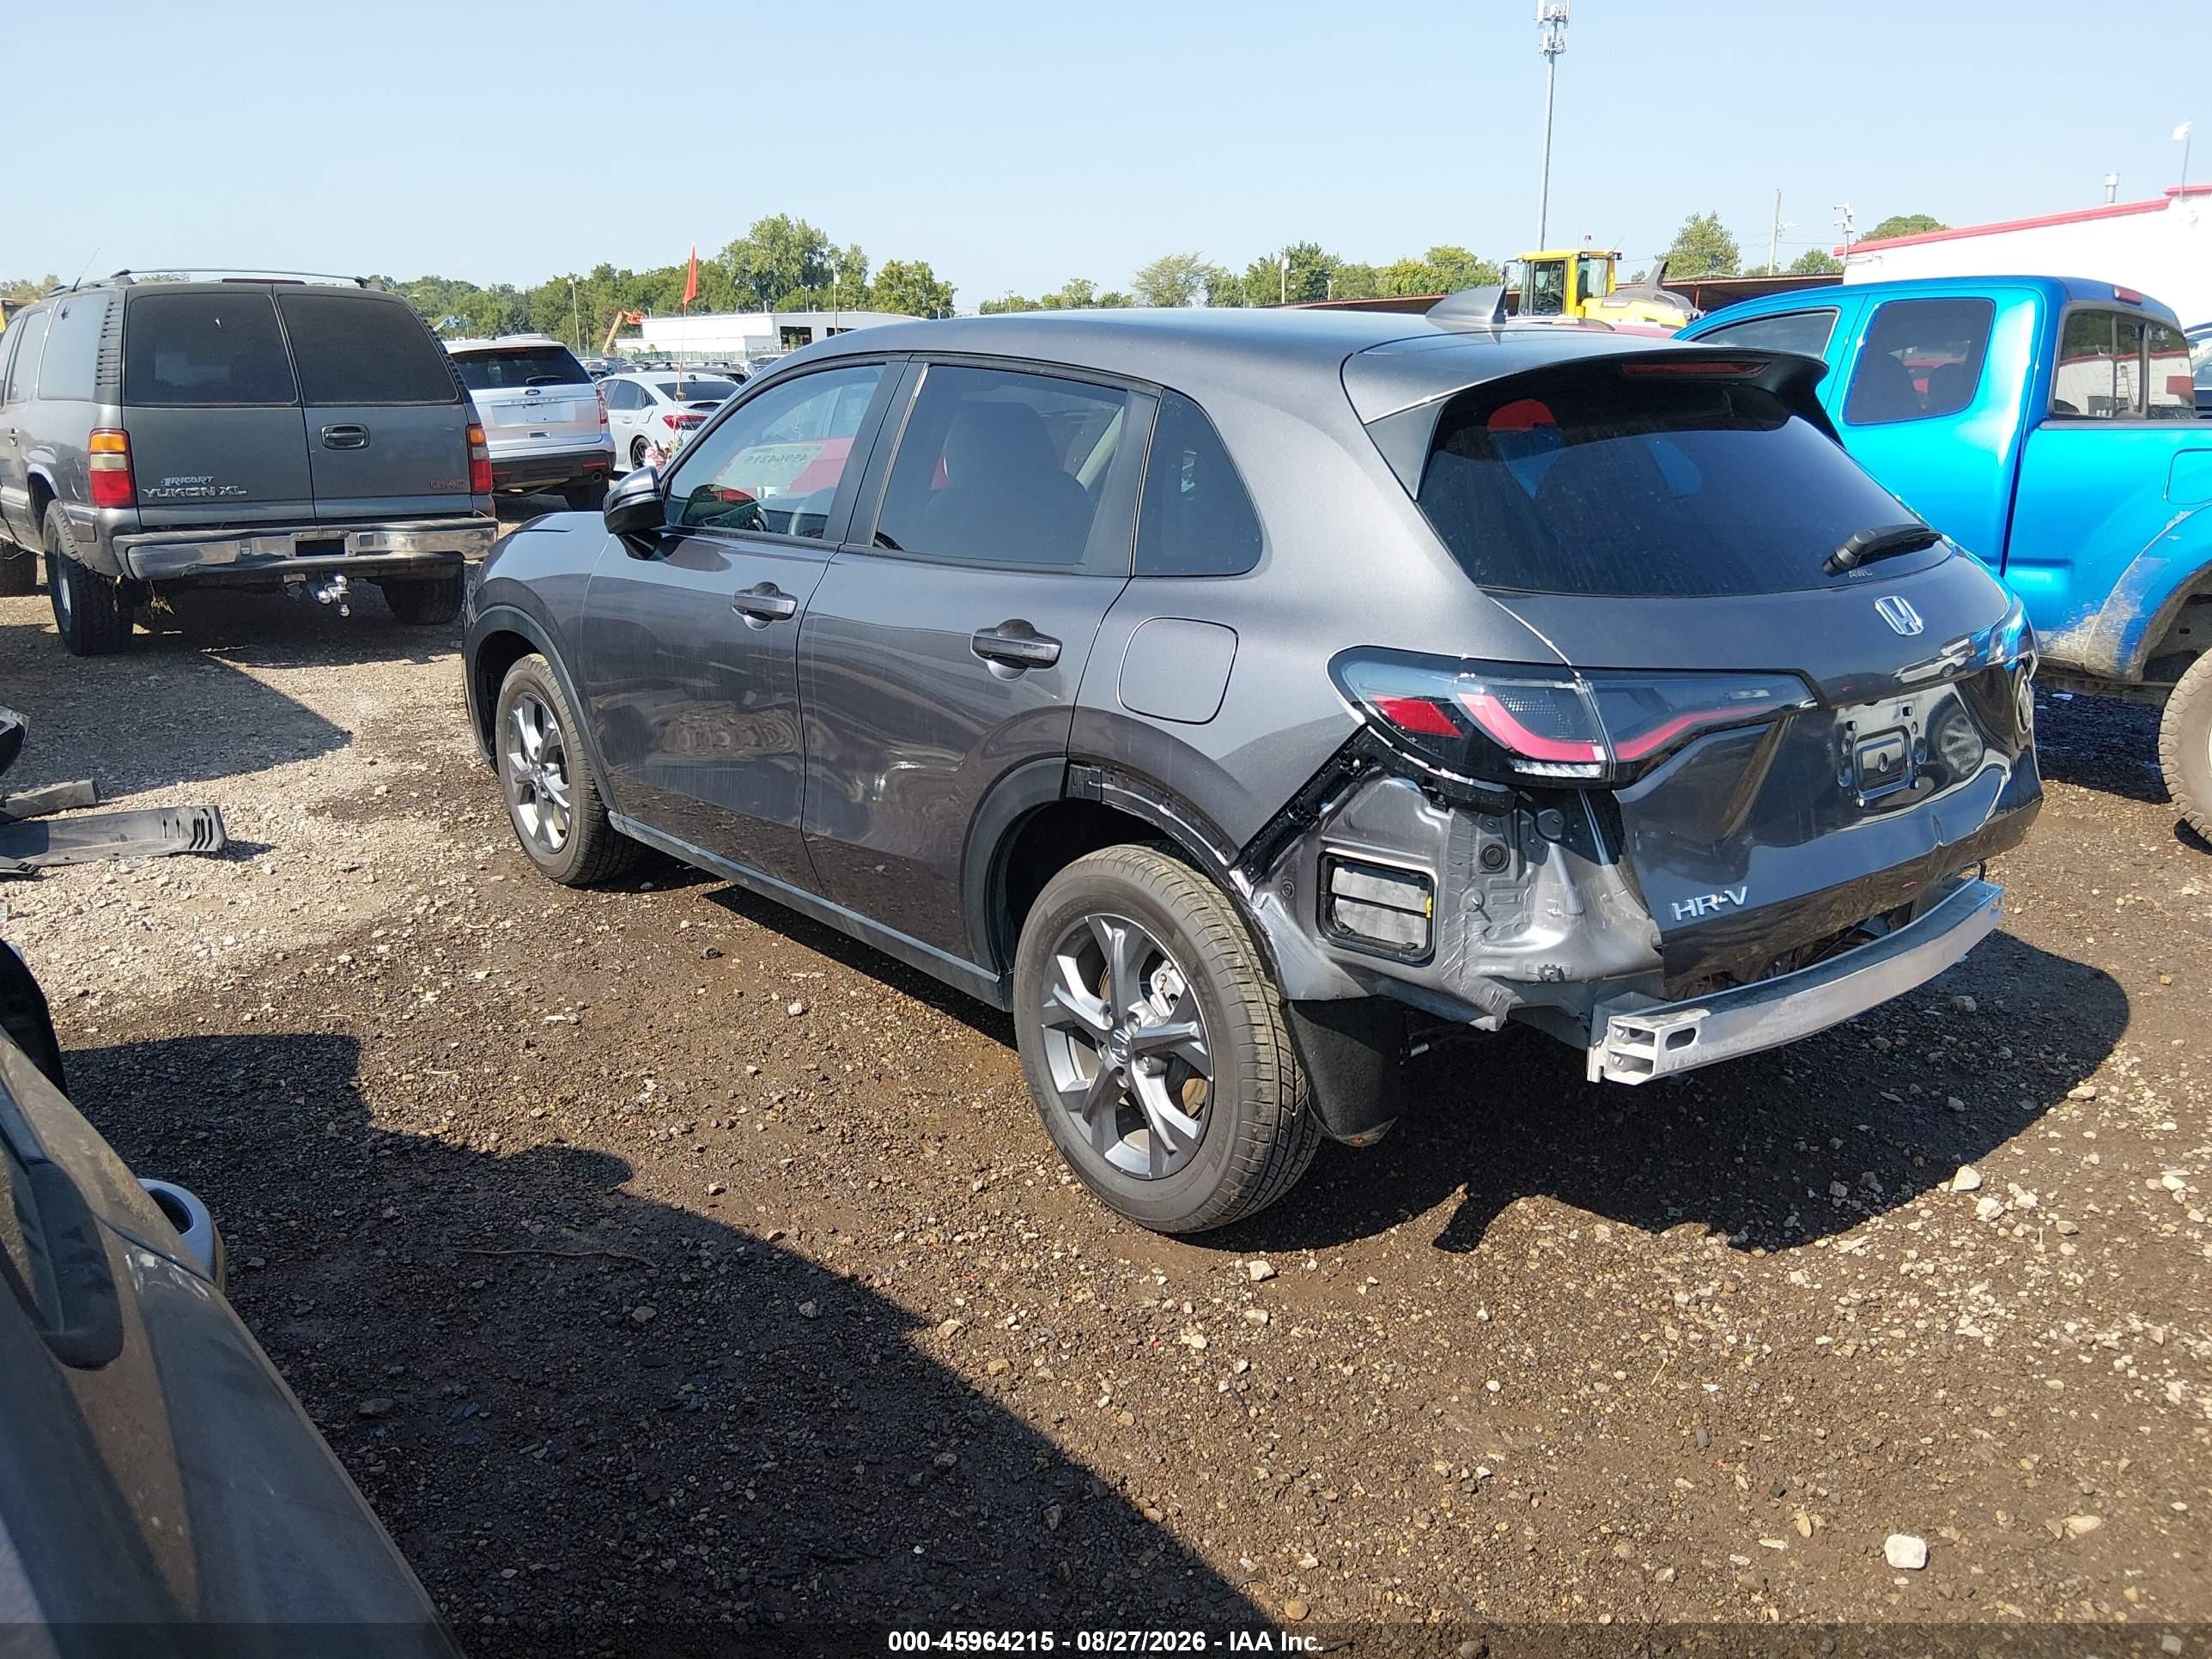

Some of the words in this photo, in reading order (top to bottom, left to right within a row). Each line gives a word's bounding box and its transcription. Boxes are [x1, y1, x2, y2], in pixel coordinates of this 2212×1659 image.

[161, 476, 214, 487] RICART
[142, 486, 216, 498] YUKON
[217, 485, 247, 495] XL
[1670, 885, 1747, 921] HR-V
